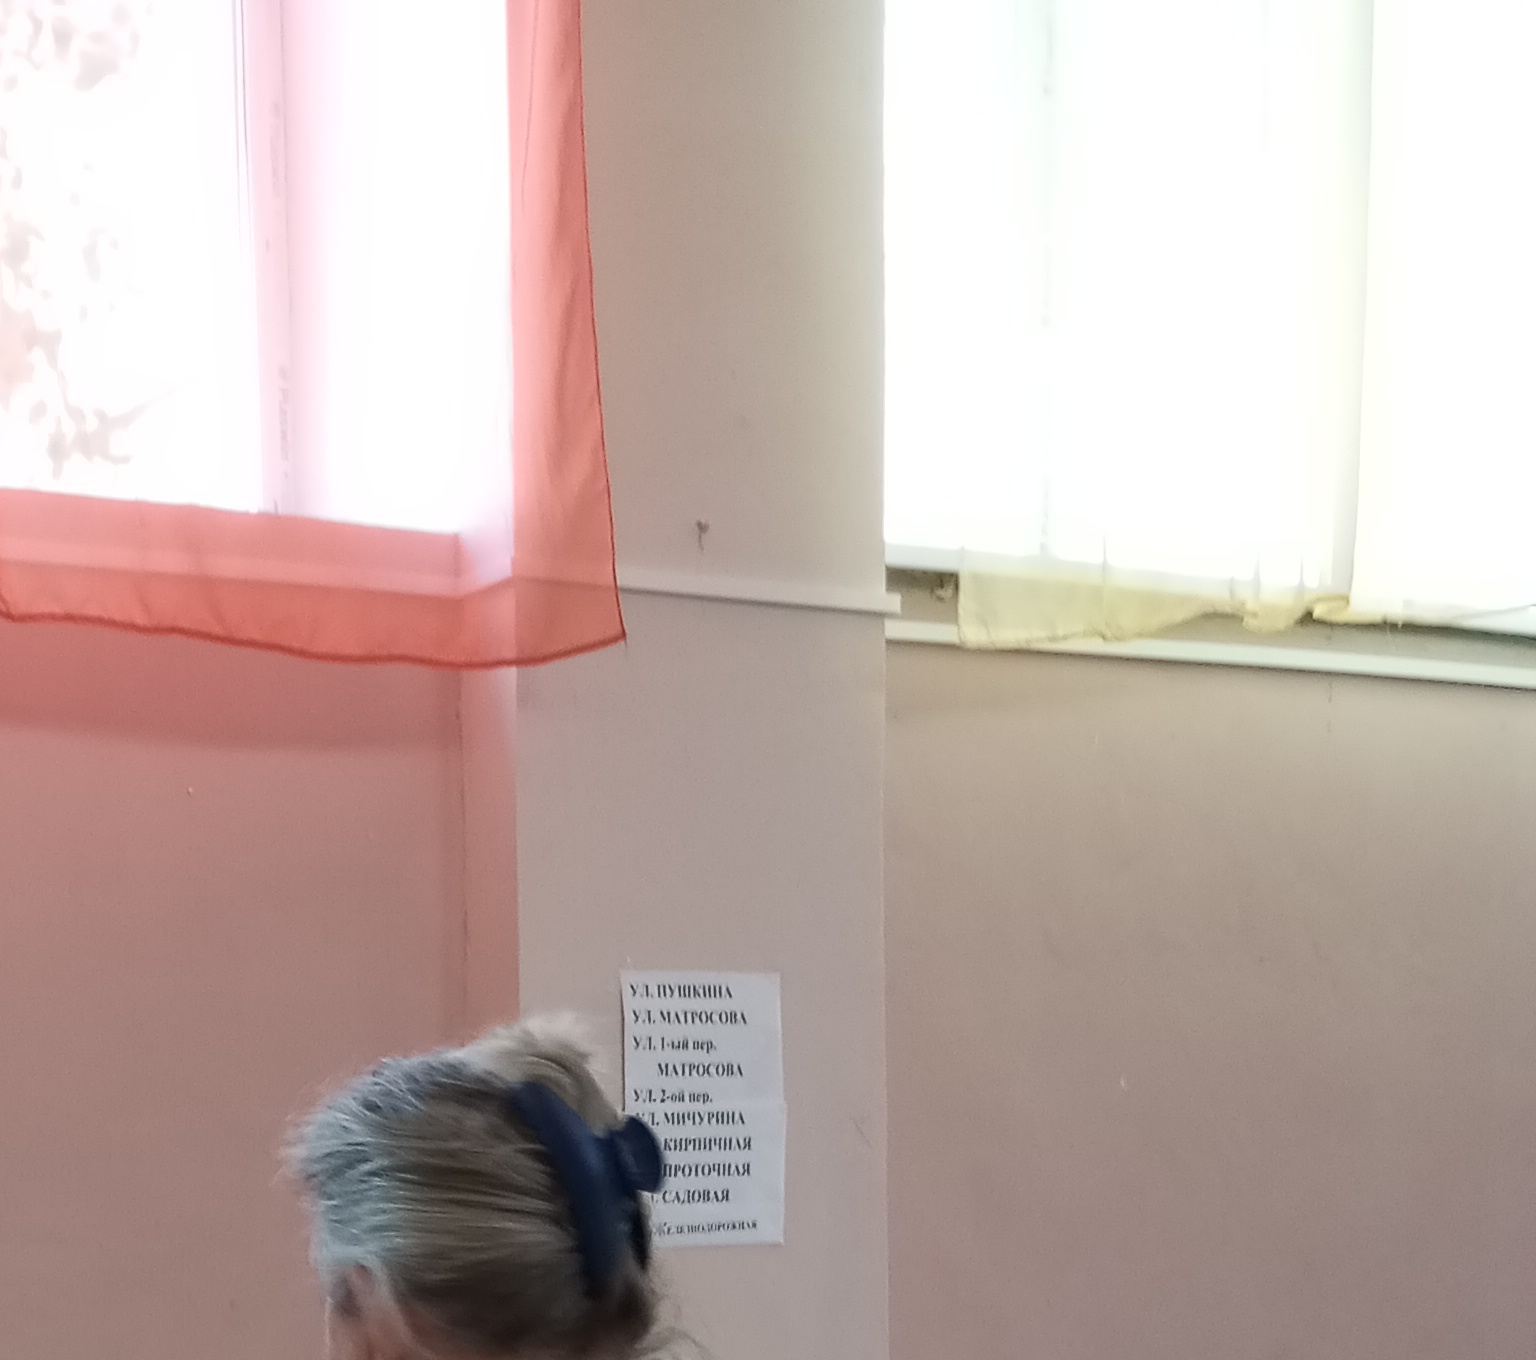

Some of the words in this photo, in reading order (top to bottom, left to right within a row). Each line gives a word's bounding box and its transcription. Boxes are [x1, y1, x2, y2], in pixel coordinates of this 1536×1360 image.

[630, 984, 653, 998] УЛ.
[657, 984, 732, 999] ПУШКИНА
[632, 1010, 655, 1024] УЛ.
[659, 1009, 747, 1025] МАТРОСОВА
[632, 1036, 655, 1050] УЛ.
[692, 1040, 716, 1054] пер.
[657, 1063, 744, 1077] МАТРОСОВА
[633, 1089, 656, 1103] УЛ.
[663, 1111, 746, 1126] МИЧУРИНА
[663, 1136, 752, 1152] КИРПИЧНАЯ
[663, 1162, 751, 1178] ПРОТОЧНАЯ
[662, 1188, 730, 1205] САДОВАЯ
